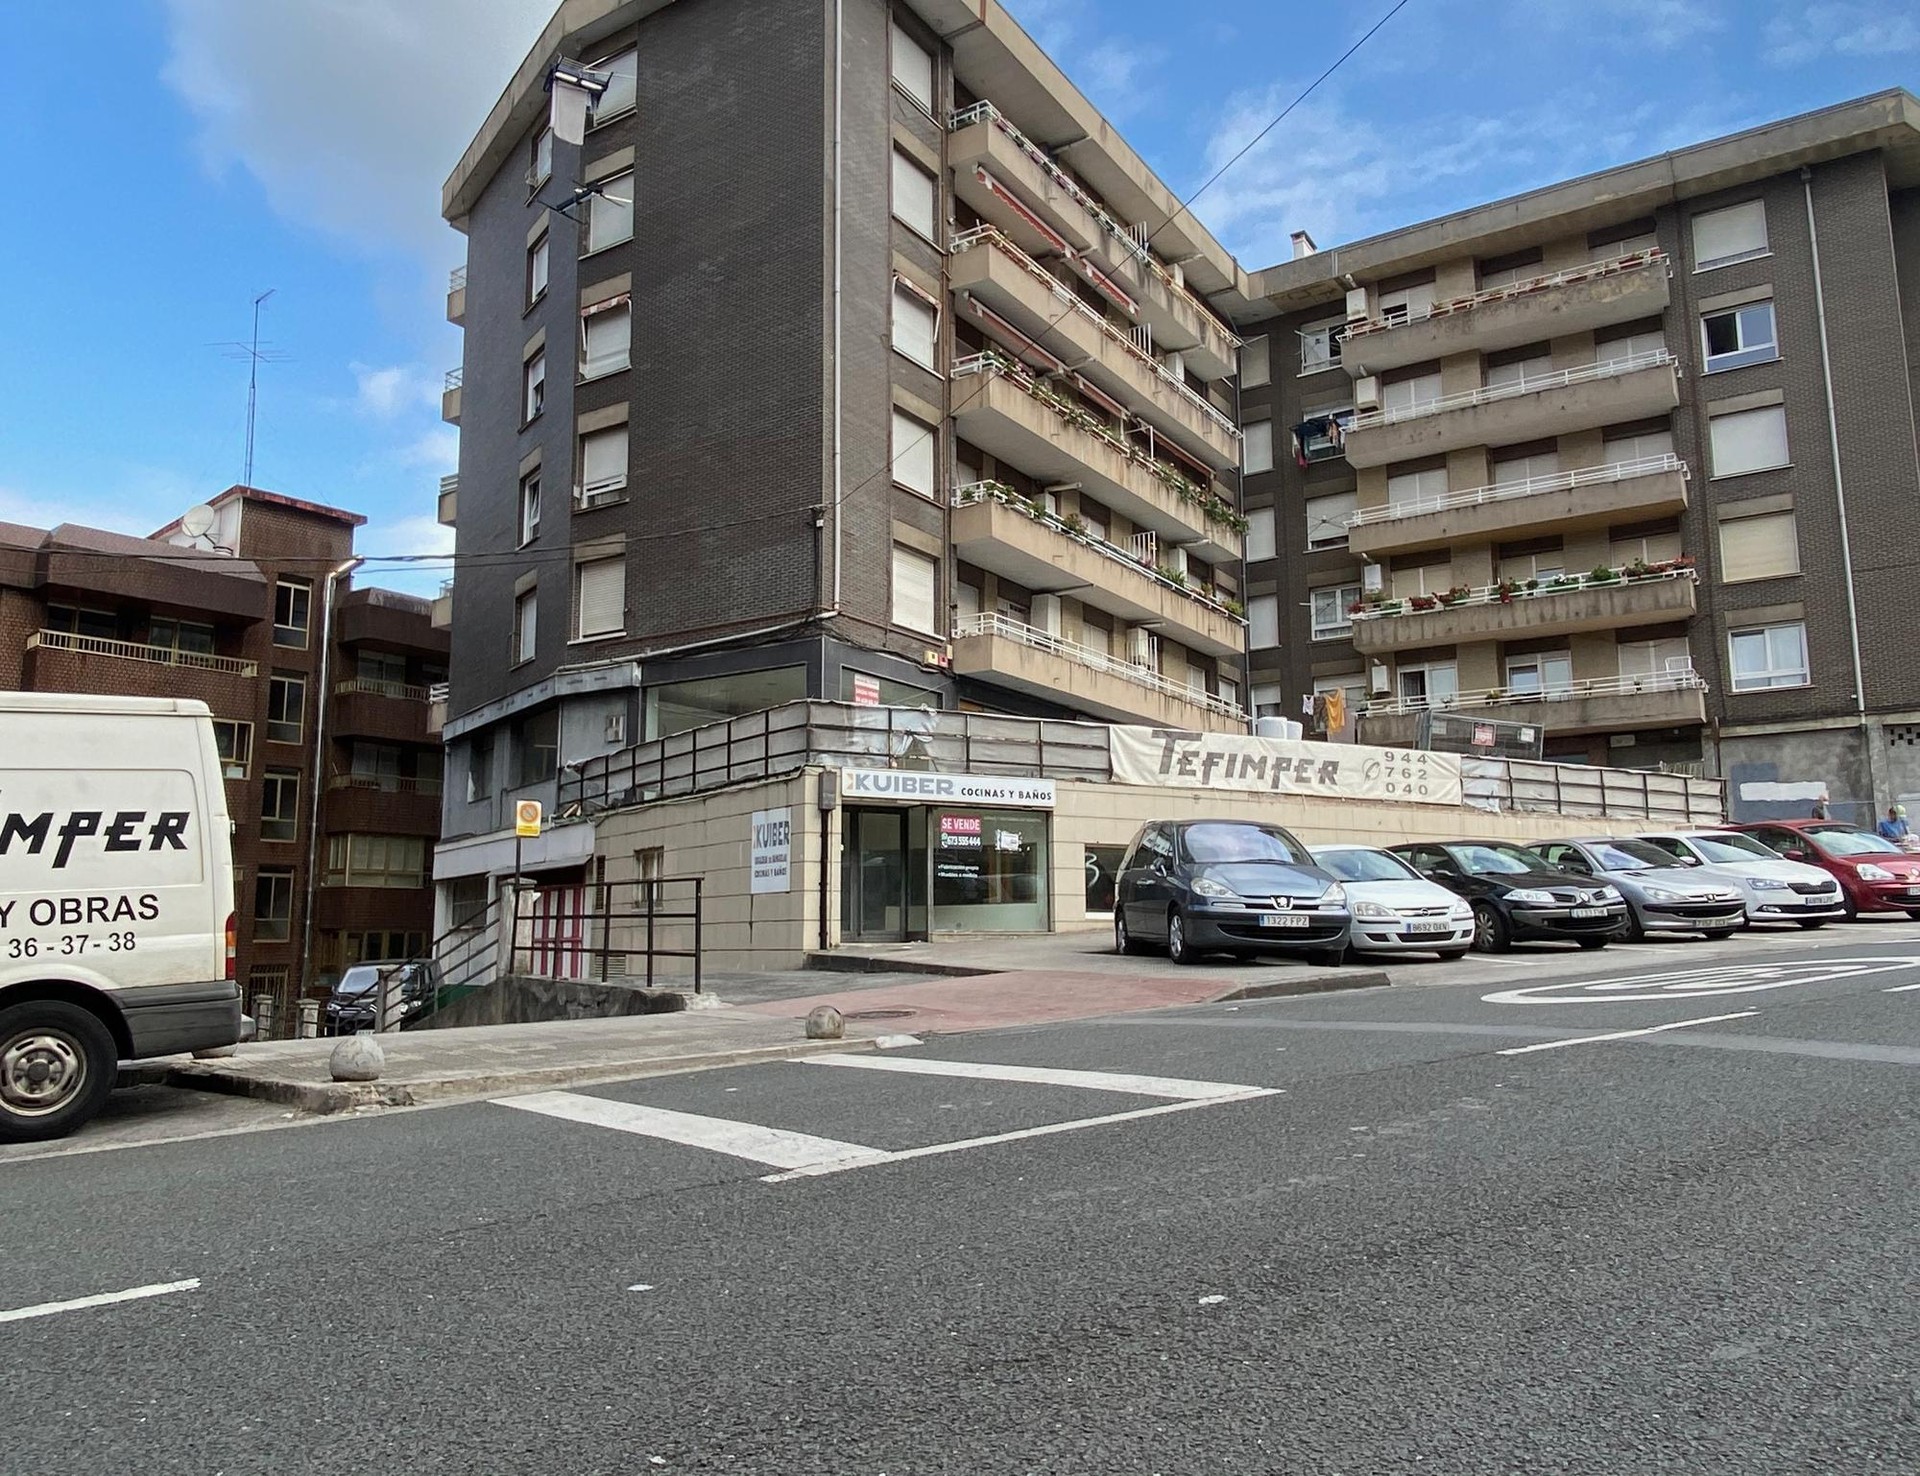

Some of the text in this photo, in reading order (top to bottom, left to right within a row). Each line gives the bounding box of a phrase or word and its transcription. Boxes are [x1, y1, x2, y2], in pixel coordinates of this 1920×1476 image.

[1151, 729, 1340, 789] TEFIMPER
[855, 773, 1052, 800] KUIBER COCINAS Y BAÑOS
[756, 820, 790, 849] KUIBER
[941, 818, 980, 831] SE VENDE
[29, 894, 159, 927] OBRAS
[1267, 916, 1308, 926] 1322 FPZ
